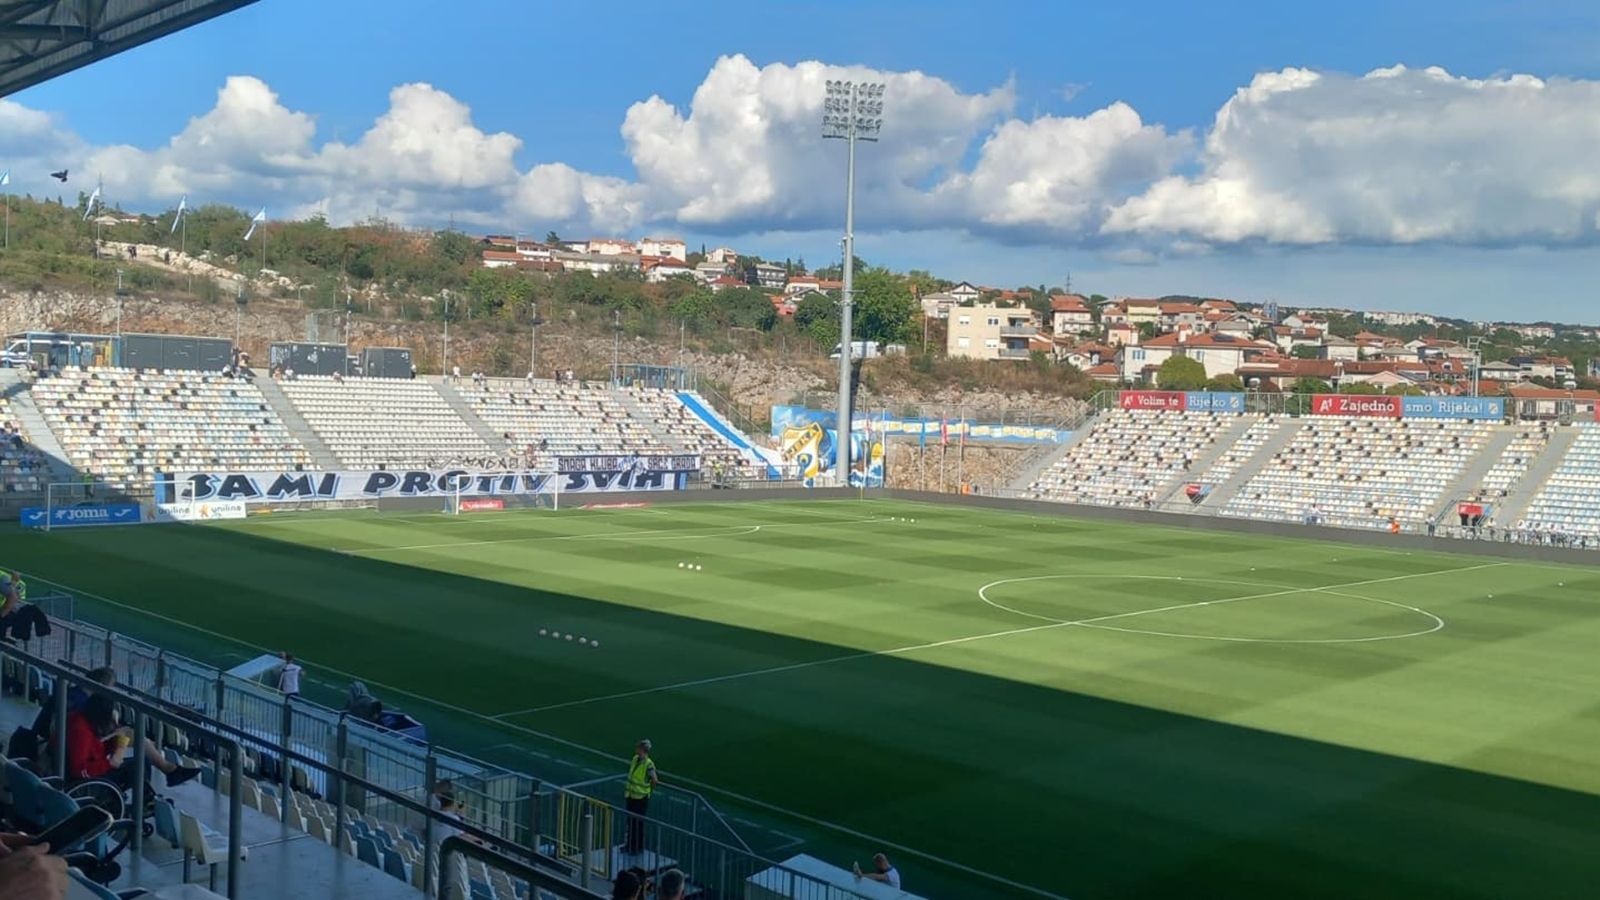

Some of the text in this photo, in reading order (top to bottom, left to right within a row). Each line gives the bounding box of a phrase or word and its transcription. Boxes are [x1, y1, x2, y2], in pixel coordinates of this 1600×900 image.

[1137, 395, 1166, 406] Volim
[1169, 395, 1179, 406] te
[1320, 399, 1483, 415] A1 Zajedno smo Rijeka!
[363, 469, 550, 498] PROTIV
[211, 504, 242, 514] uniline
